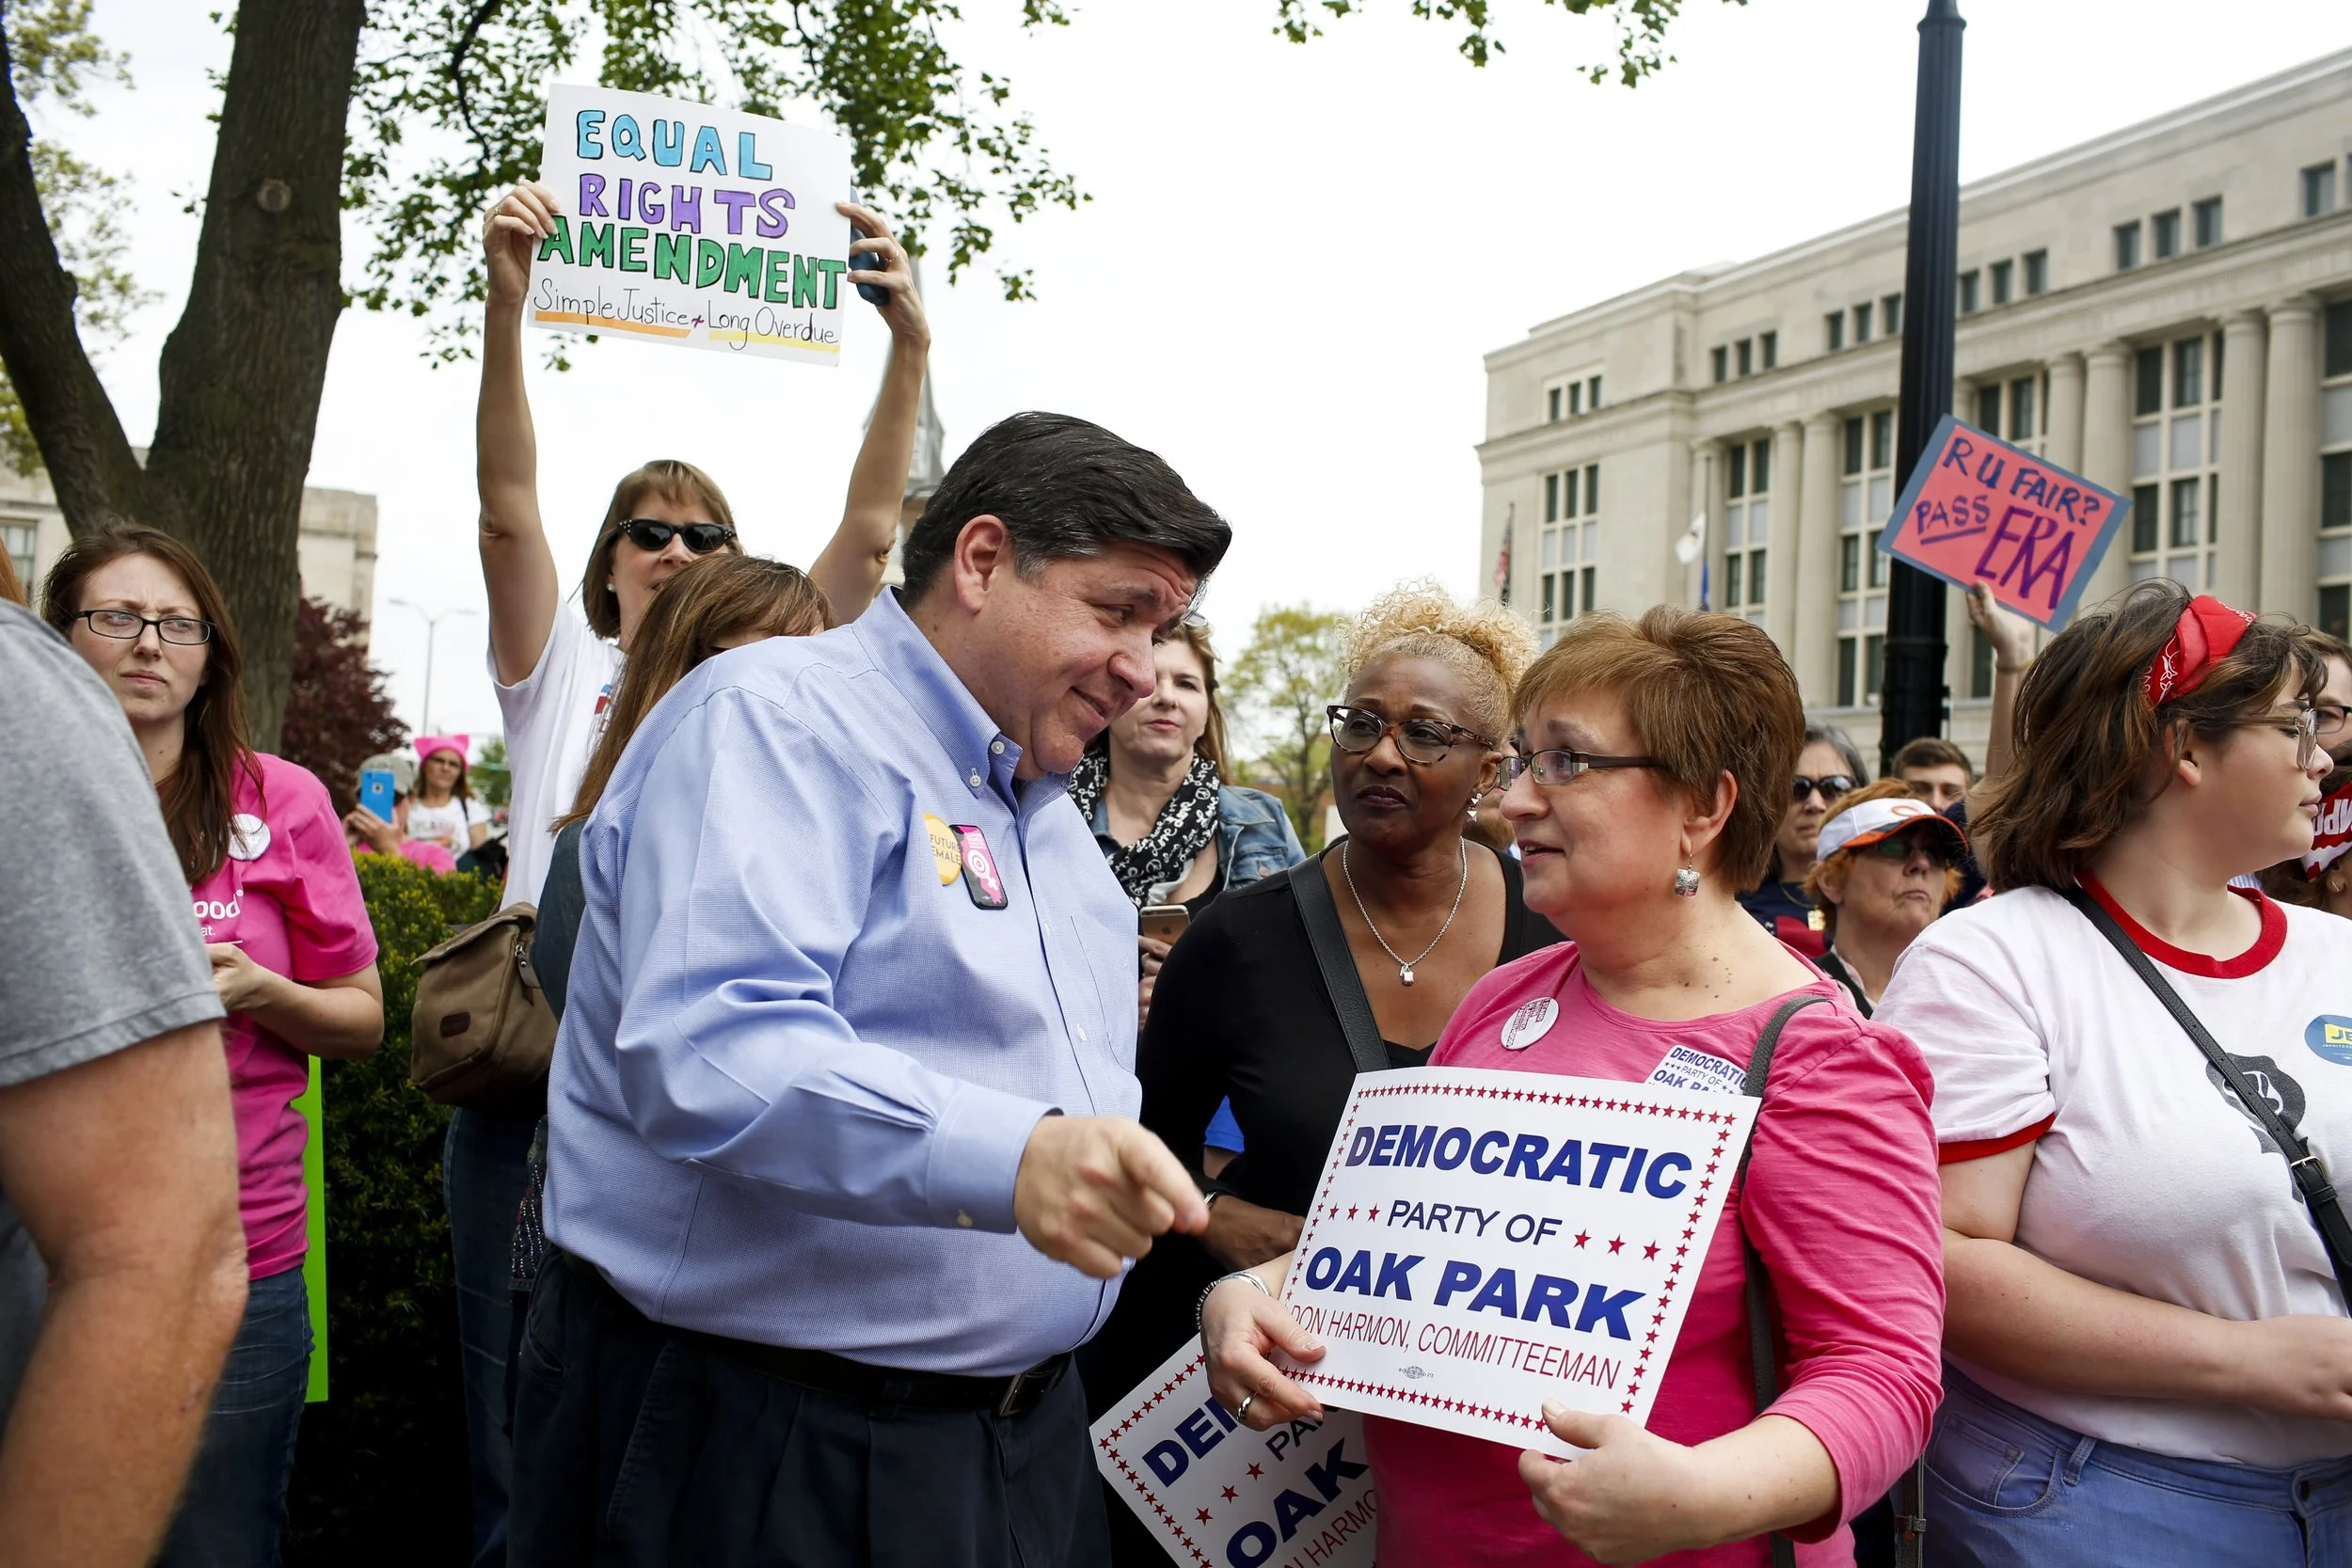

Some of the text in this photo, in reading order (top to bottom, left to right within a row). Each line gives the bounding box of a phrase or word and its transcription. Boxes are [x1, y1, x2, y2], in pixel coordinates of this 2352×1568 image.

[577, 110, 772, 181] EQUAL
[580, 173, 795, 238] RIGHTS
[537, 215, 846, 309] AMENDMENT
[533, 278, 615, 325] Simple
[617, 289, 690, 325] Justice
[708, 300, 750, 351] Long
[755, 307, 838, 343] Overdue
[1943, 437, 2101, 526] R U FAIR?
[1915, 495, 2075, 610] PASS ERA
[930, 833, 961, 853] FUTURE
[1654, 1069, 1689, 1088] OAK
[1681, 1066, 1722, 1086] PARTY OF
[1345, 1125, 1692, 1199] DEMOCRATIC
[1388, 1199, 1562, 1245] PARTY OF
[1306, 1246, 1646, 1341] OAK PARK
[1327, 1310, 1410, 1354] HARMON,
[1418, 1323, 1621, 1390] COMMITTEEMAN
[1265, 1418, 1324, 1463] PA
[1226, 1437, 1369, 1568] OAK
